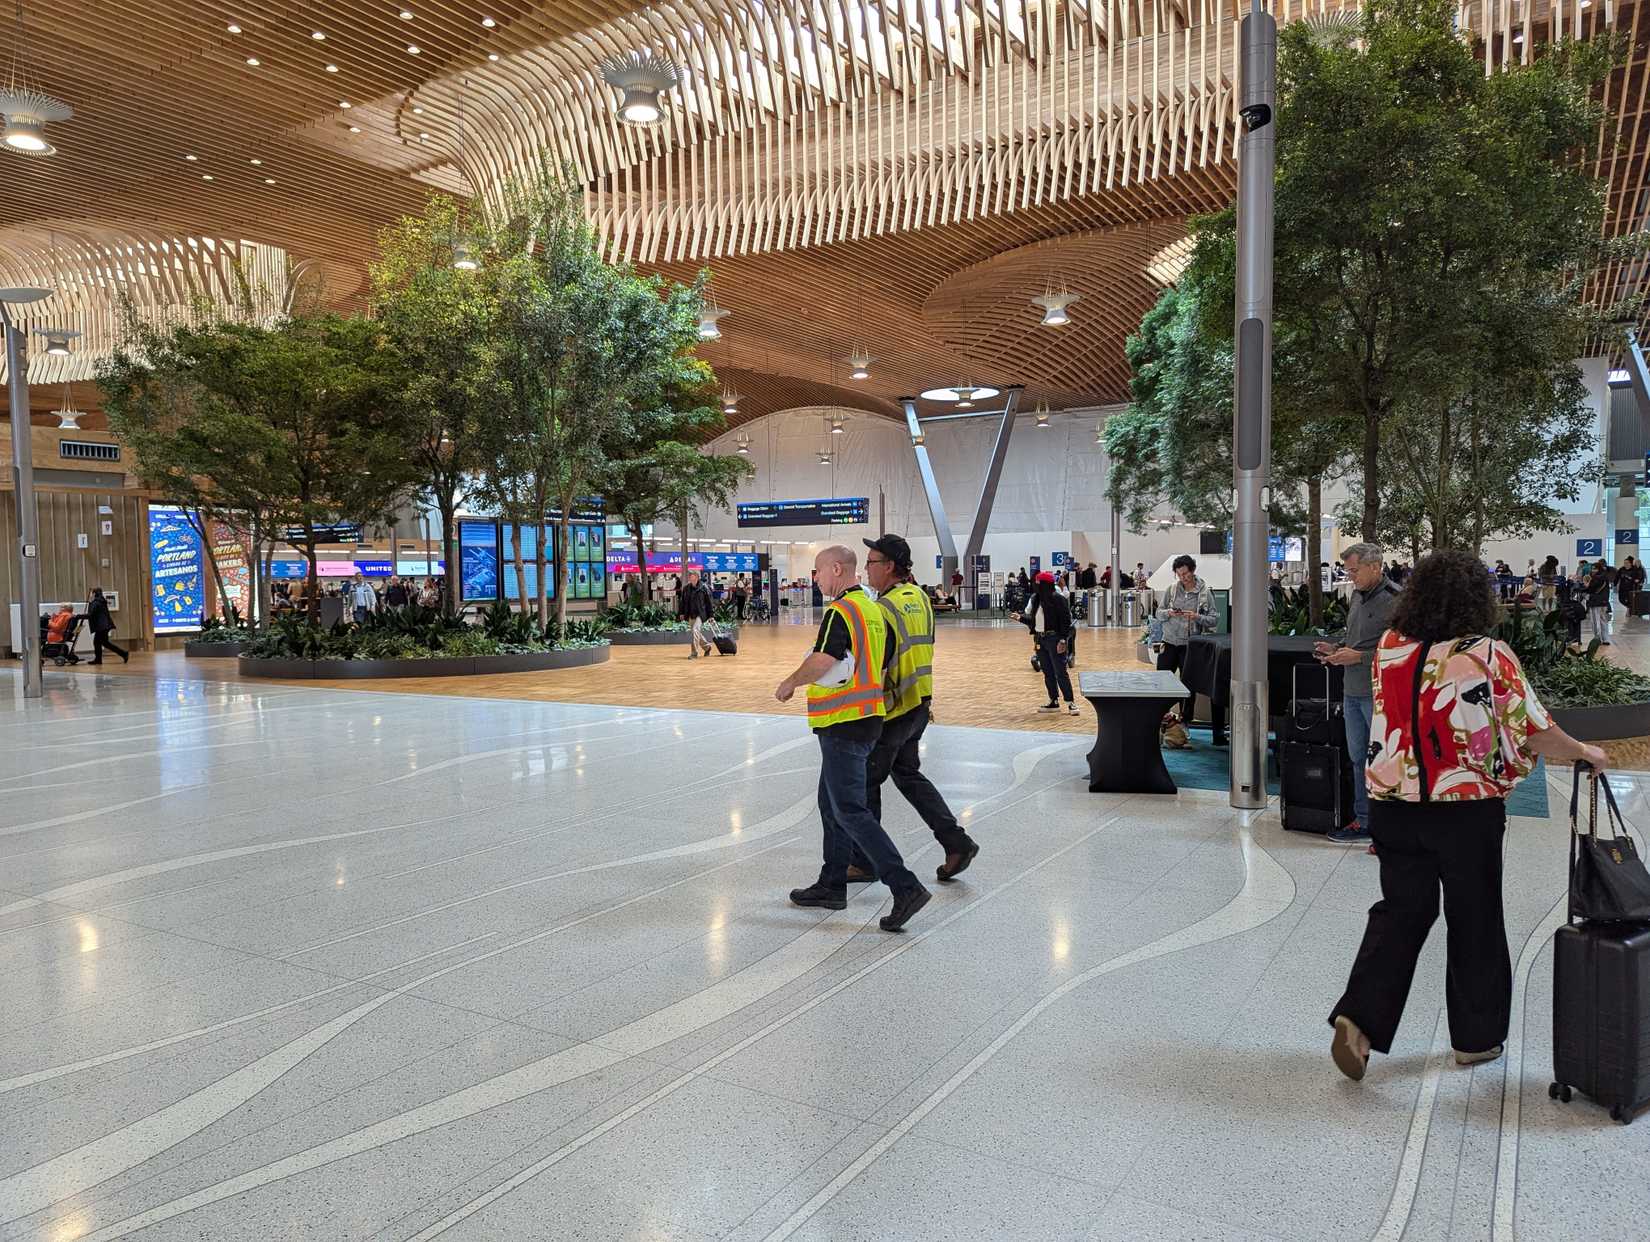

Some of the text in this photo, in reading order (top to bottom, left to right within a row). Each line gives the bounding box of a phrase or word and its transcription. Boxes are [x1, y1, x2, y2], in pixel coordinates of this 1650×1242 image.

[1622, 531, 1632, 543] 2
[1583, 541, 1595, 555] 2
[156, 550, 197, 563] PORTLAND
[1056, 553, 1065, 565] 3
[155, 564, 199, 578] ARTESANOS
